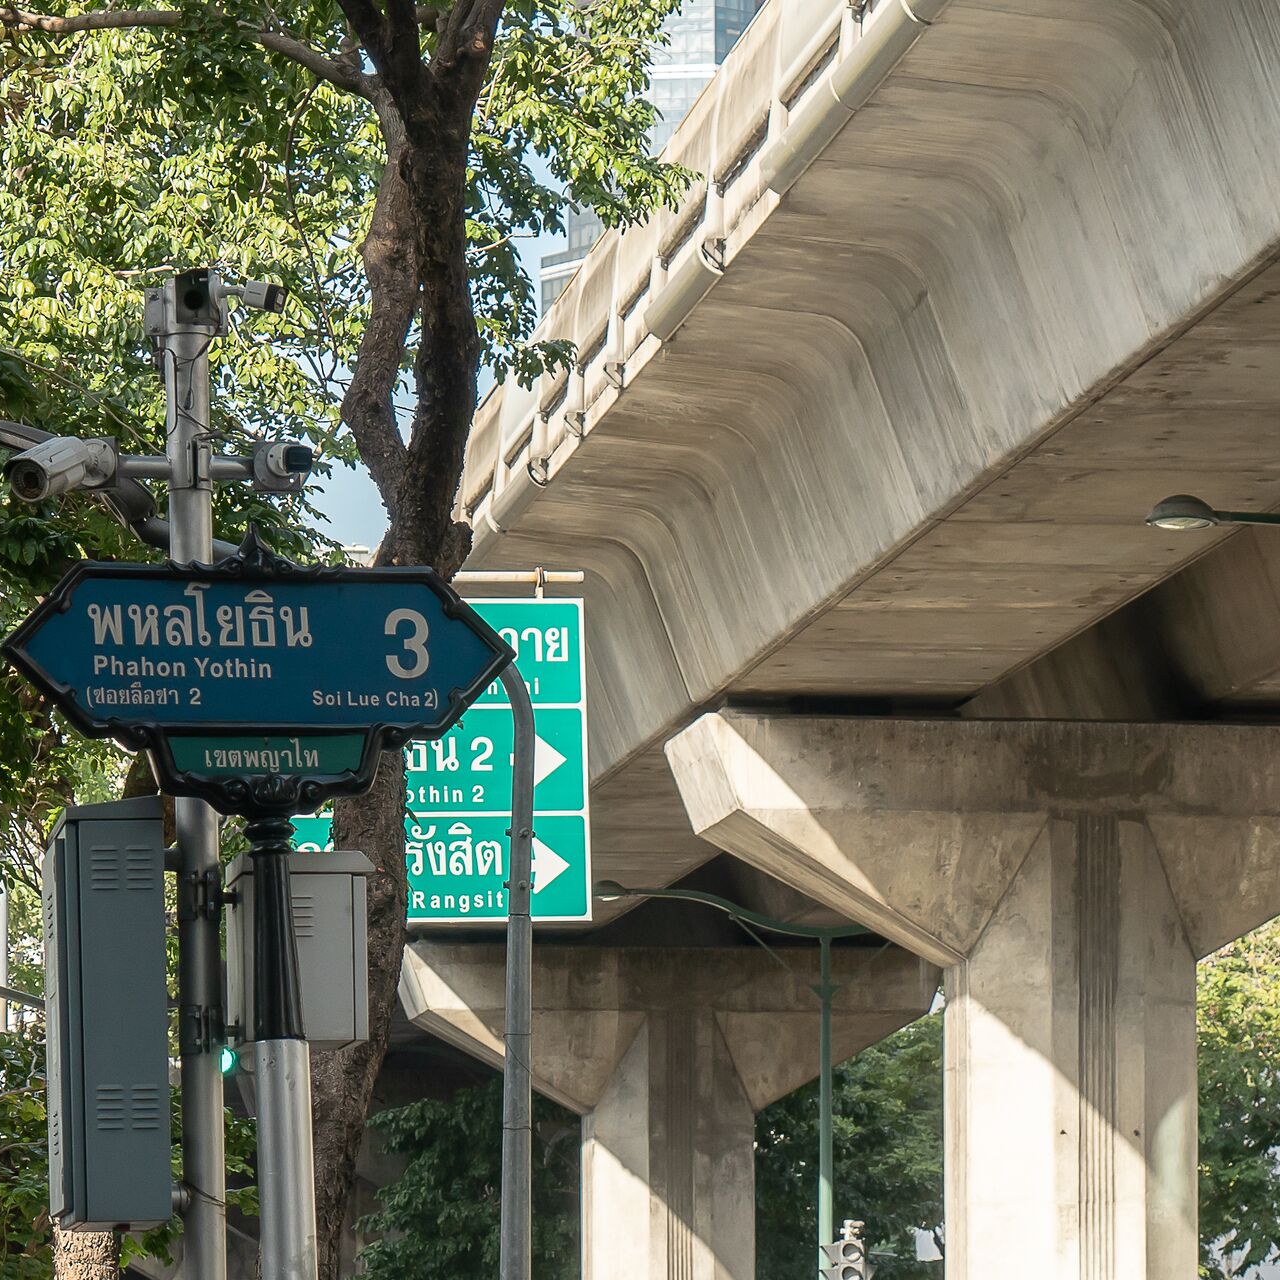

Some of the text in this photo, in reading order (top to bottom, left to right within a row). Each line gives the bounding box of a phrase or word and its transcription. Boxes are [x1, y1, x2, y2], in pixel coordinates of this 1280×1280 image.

[87, 581, 430, 680] พหลโยธิน 3
[93, 655, 272, 679] Phahon Yothin
[189, 687, 202, 706] 2
[312, 690, 341, 707] Soi
[347, 691, 380, 707] Lue
[205, 738, 319, 773] เขตพญาไท
[470, 736, 494, 772] 2
[471, 785, 485, 803] 2
[412, 890, 503, 913] Rangsit
